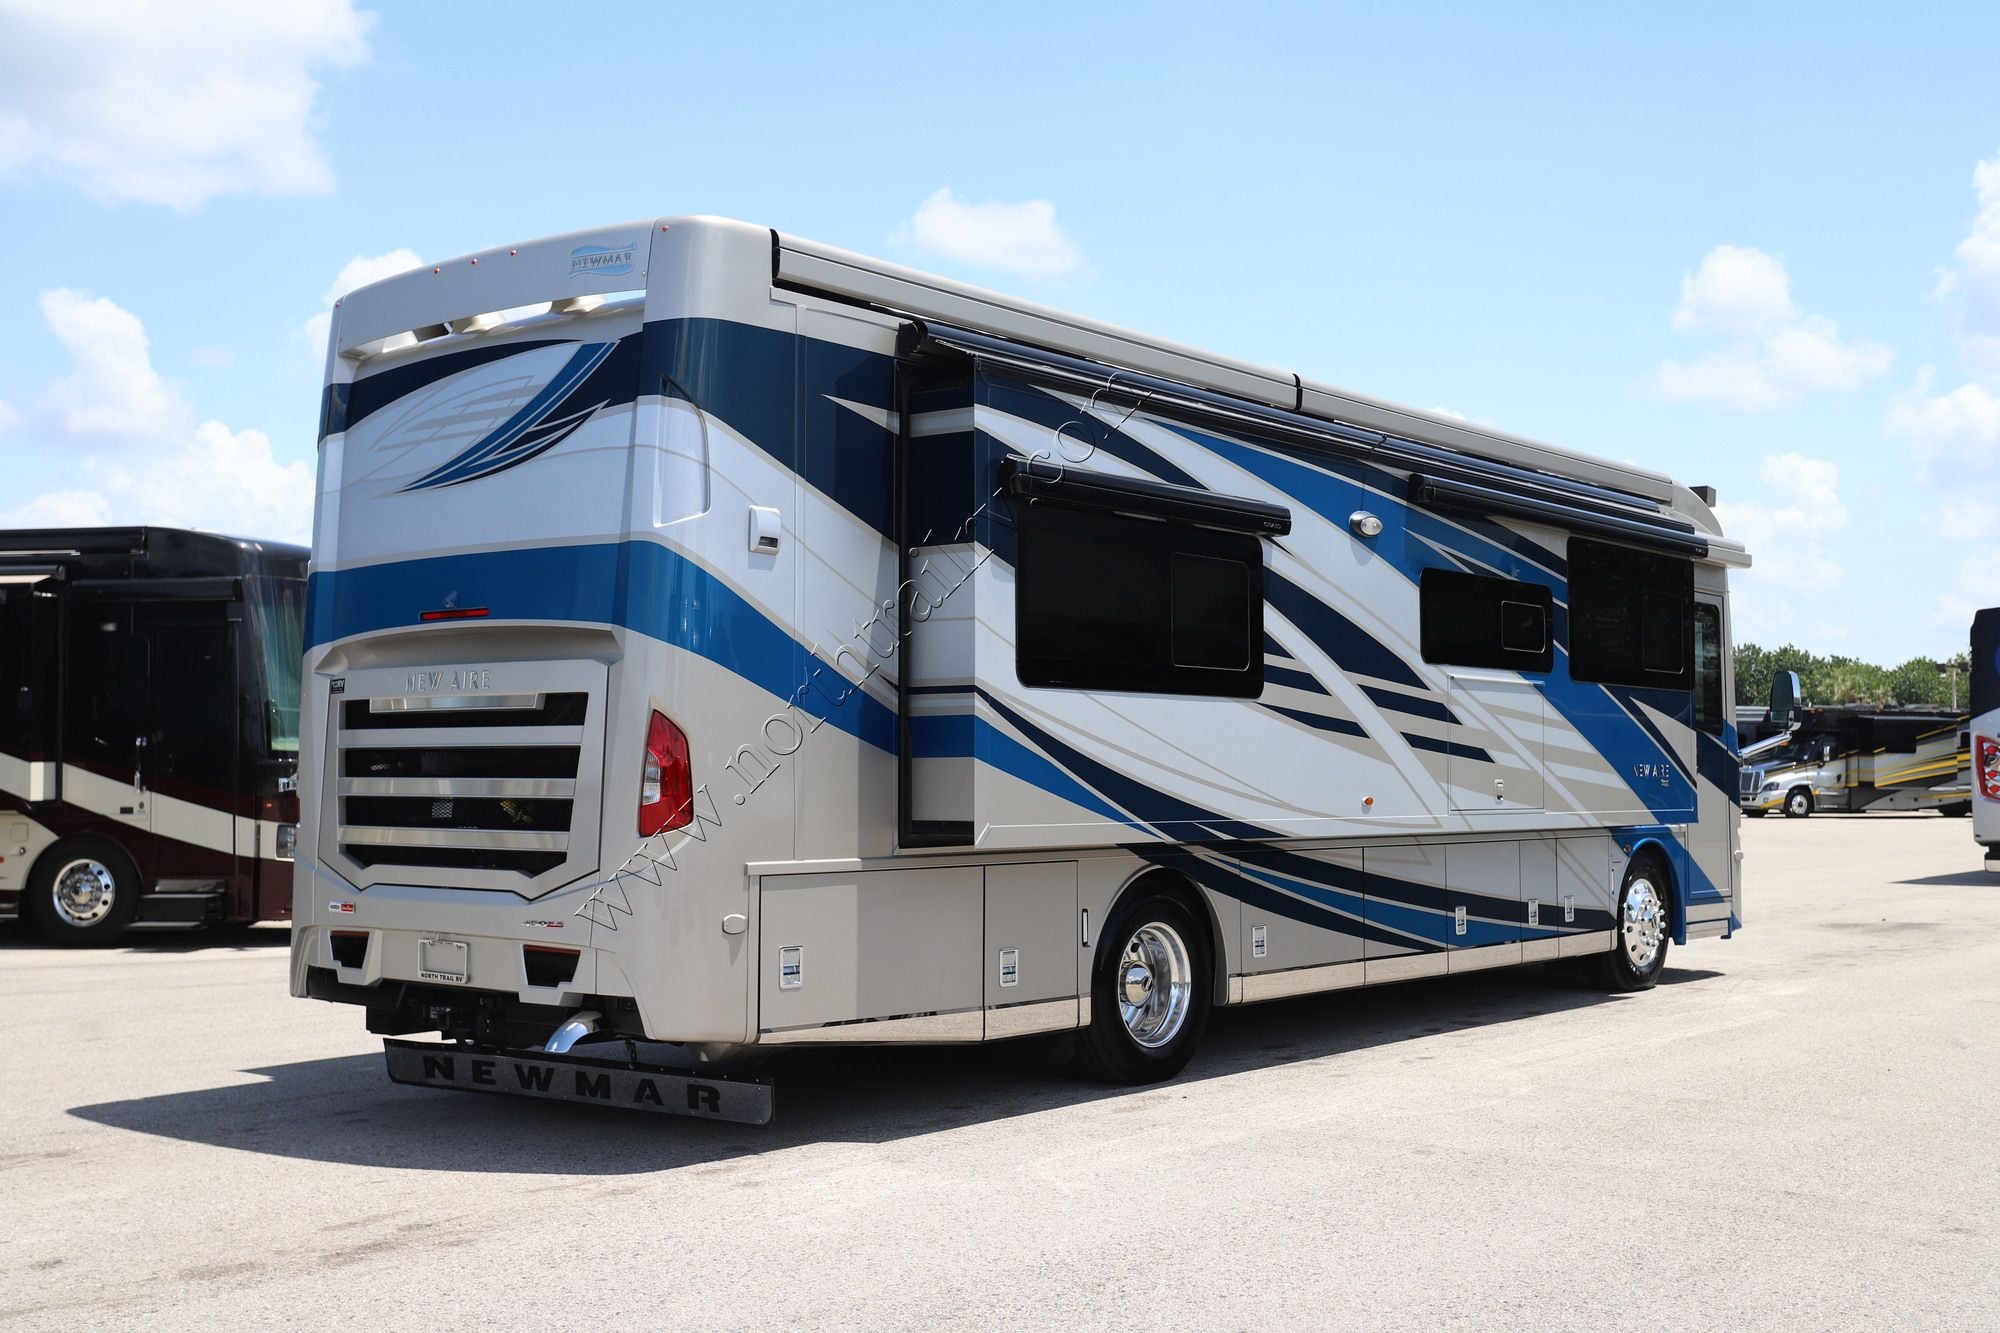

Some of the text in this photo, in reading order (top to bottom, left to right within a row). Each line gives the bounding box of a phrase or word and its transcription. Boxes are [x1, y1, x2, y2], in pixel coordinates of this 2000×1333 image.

[570, 252, 632, 272] NEWMAR
[405, 668, 491, 693] NEW AIRE
[1633, 763, 1670, 777] NEW ARE
[440, 974, 454, 982] TRAIL
[422, 1055, 721, 1113] NEWMAR
